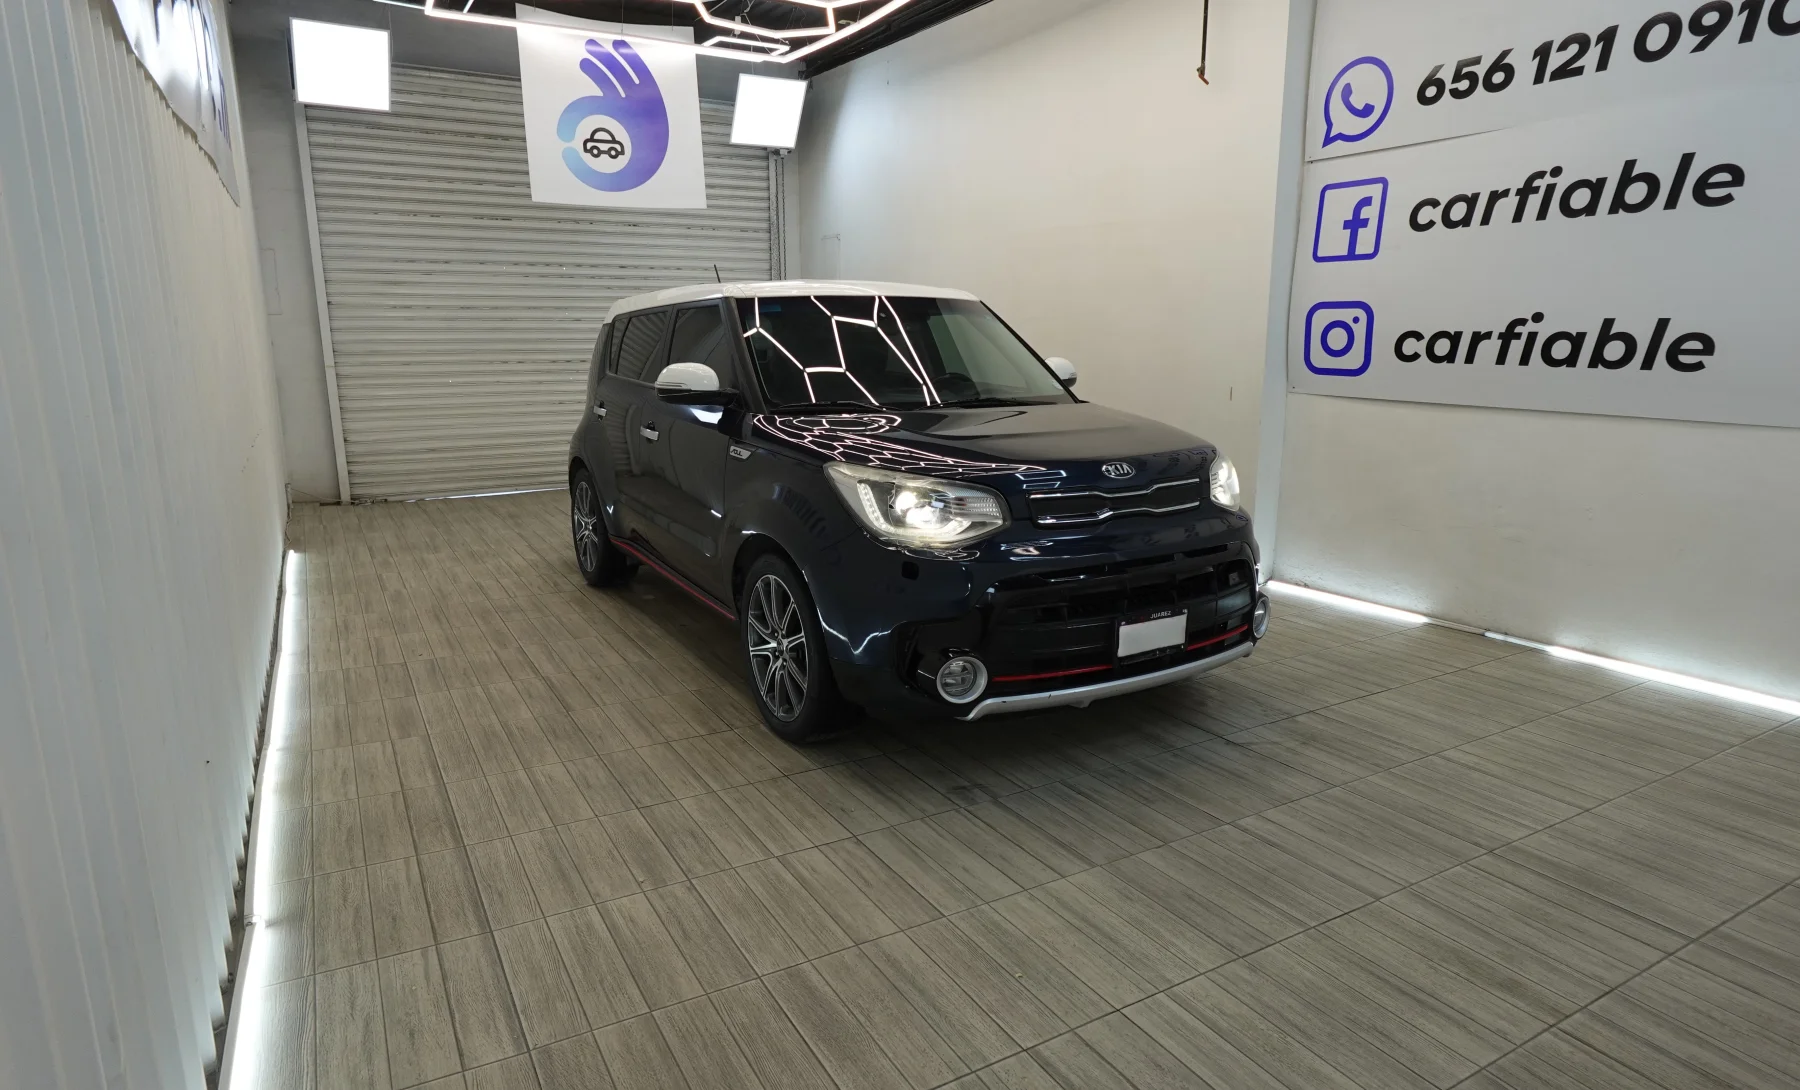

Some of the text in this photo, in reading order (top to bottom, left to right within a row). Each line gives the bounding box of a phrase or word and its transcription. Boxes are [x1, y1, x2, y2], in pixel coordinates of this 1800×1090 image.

[1416, 49, 1516, 107] 656
[1531, 25, 1620, 86] 121
[1408, 152, 1746, 233] carfiable
[1393, 312, 1716, 373] carfiable
[1107, 464, 1132, 475] KIA
[1150, 610, 1172, 619] JUAREZ
